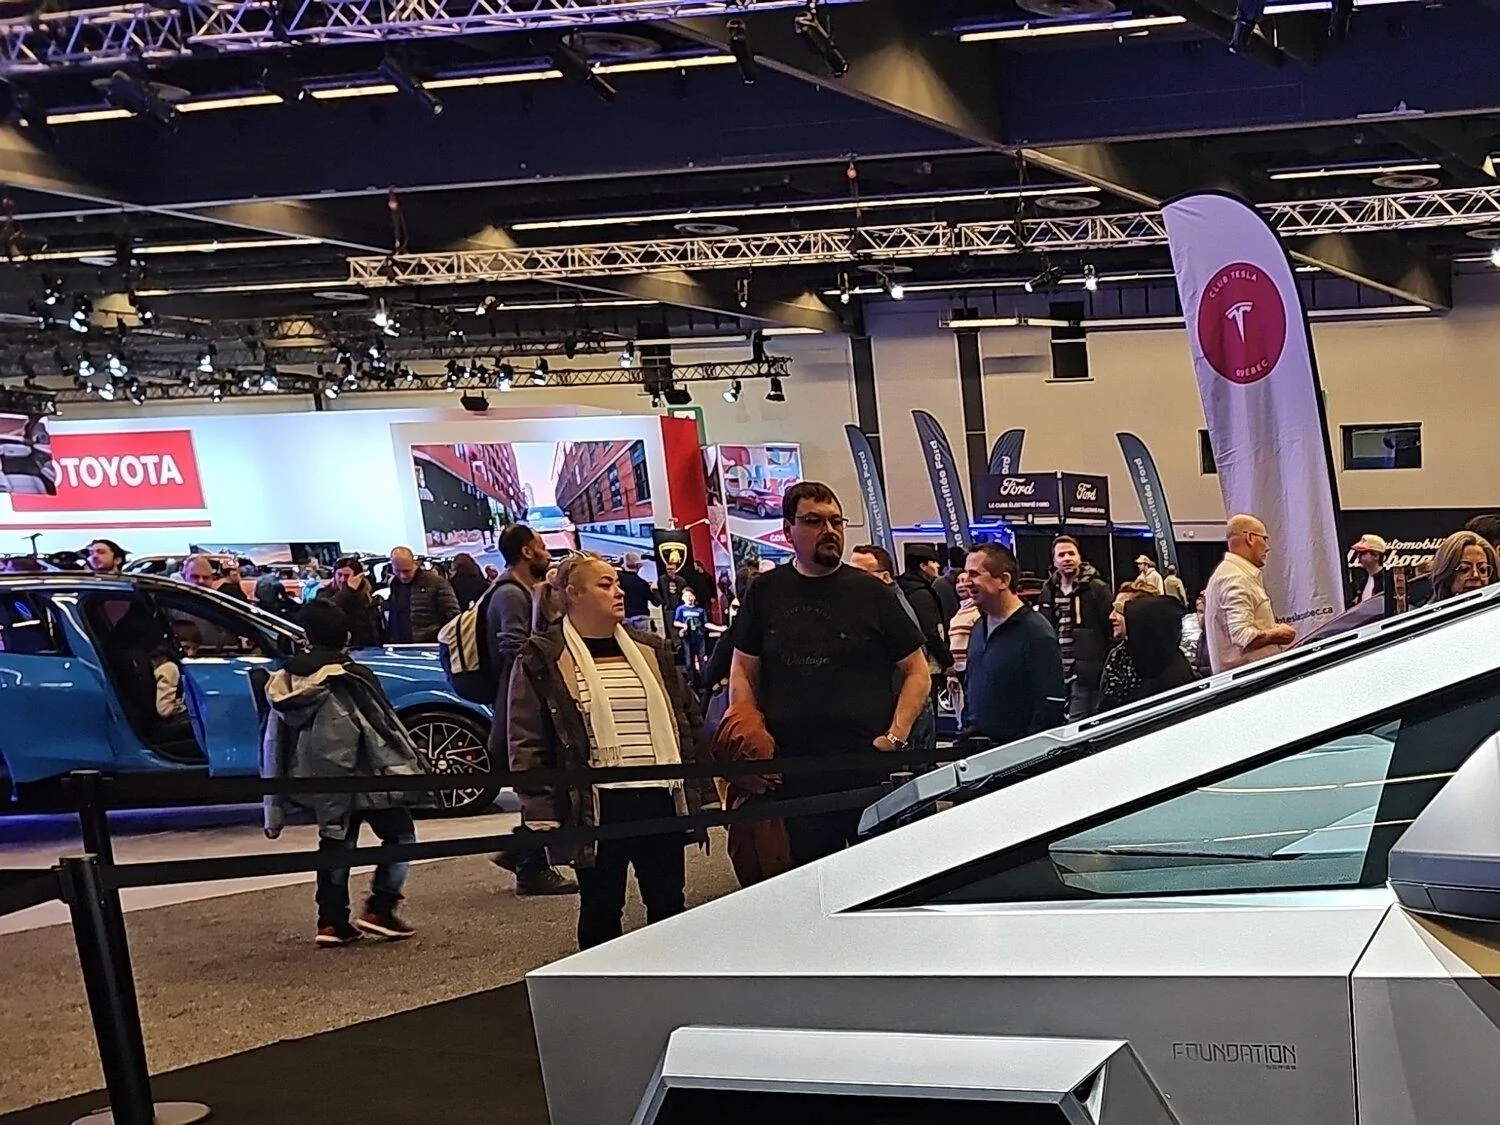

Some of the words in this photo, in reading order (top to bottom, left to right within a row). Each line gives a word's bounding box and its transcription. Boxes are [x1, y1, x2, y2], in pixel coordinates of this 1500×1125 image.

[1208, 277, 1229, 299] CLUB
[1230, 269, 1258, 283] TESLA
[858, 450, 871, 478] Ford
[929, 440, 944, 469] Ford
[1001, 456, 1011, 474] ord
[61, 454, 185, 488] TOYOTA
[1133, 457, 1148, 484] Ford
[1000, 477, 1035, 496] Ford
[1076, 482, 1097, 501] Ford
[1384, 538, 1446, 550] utomobili
[1172, 1042, 1297, 1064] FOUNDATION
